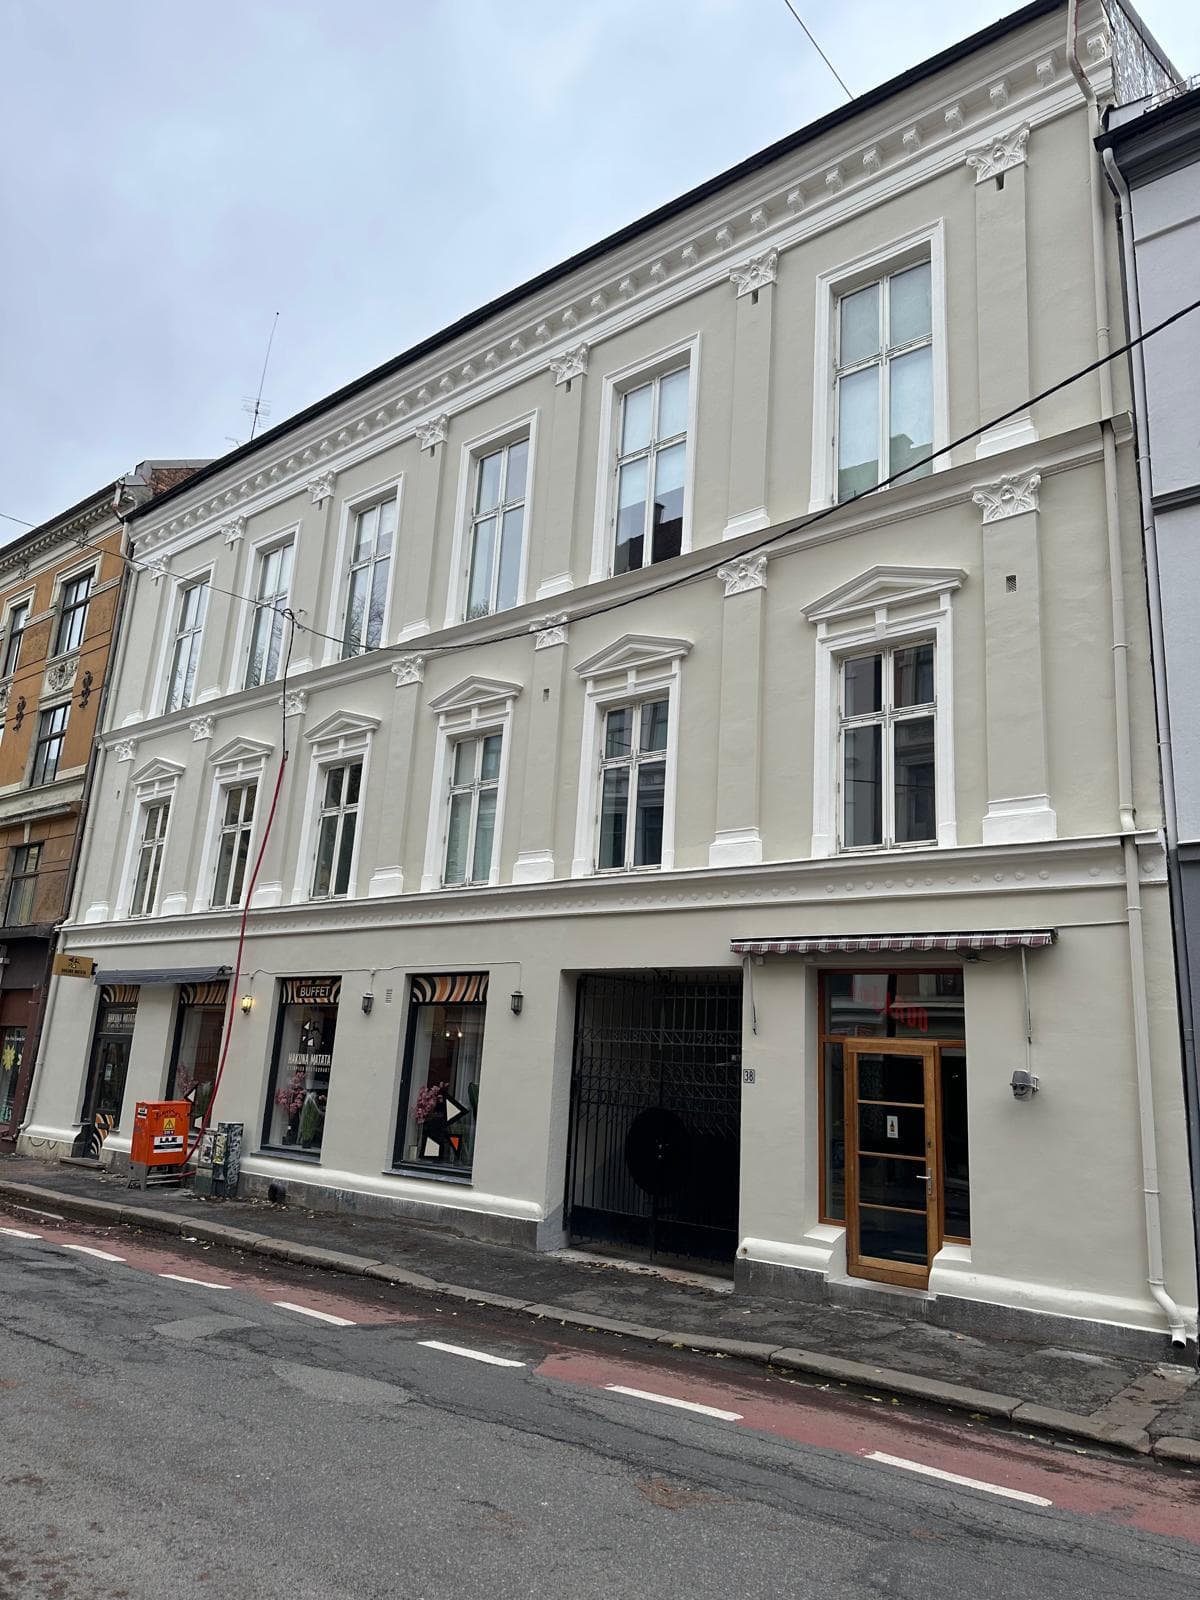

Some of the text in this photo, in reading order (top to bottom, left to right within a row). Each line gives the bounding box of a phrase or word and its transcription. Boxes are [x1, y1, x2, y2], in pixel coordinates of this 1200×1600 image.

[300, 986, 330, 997] BUFFET
[288, 1053, 330, 1066] HAKUNA MATATA
[744, 1070, 754, 1082] 38
